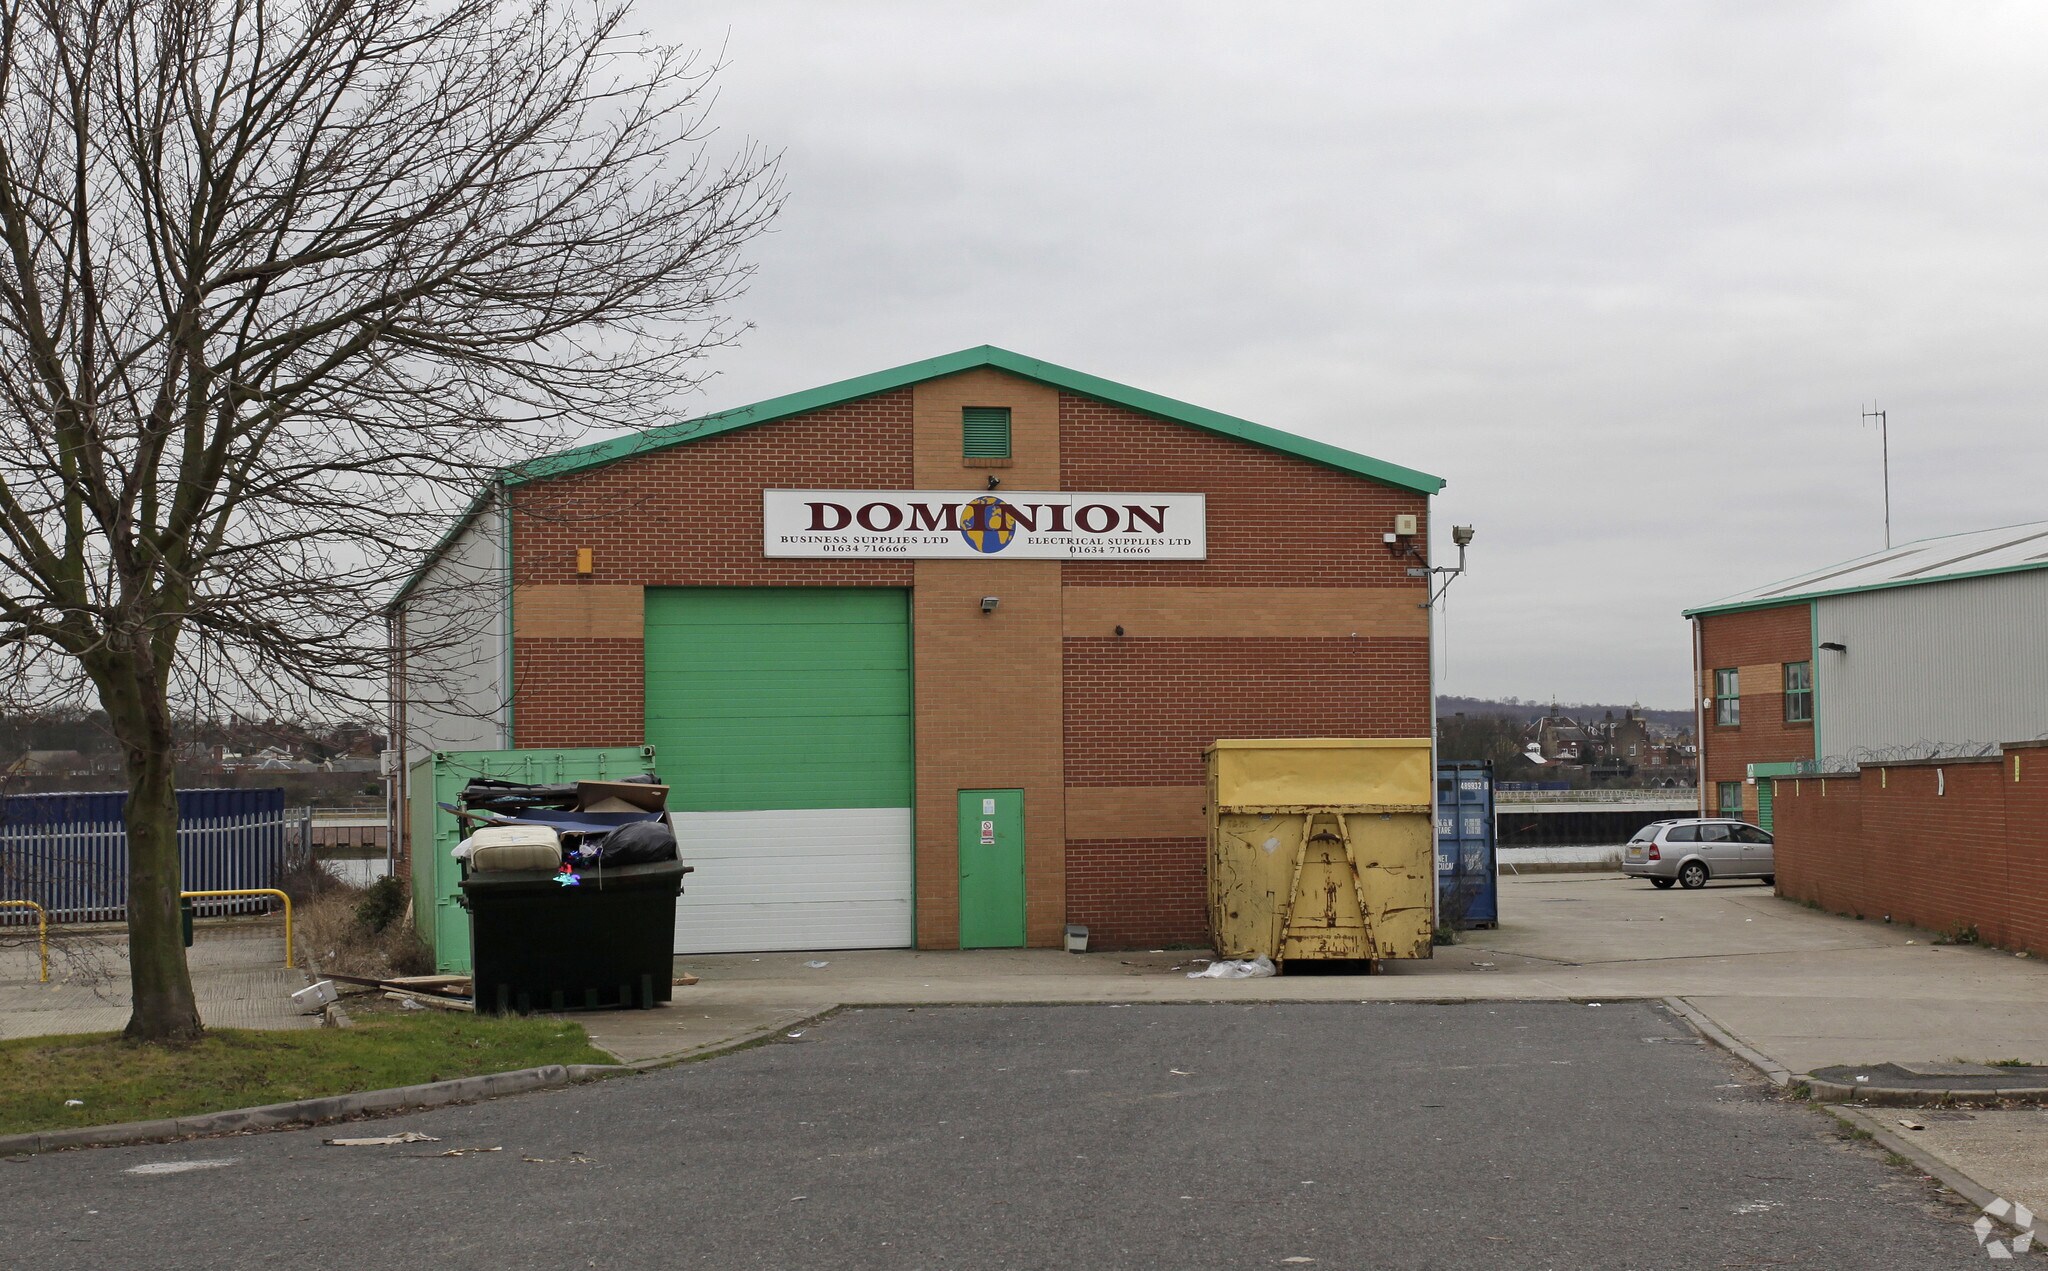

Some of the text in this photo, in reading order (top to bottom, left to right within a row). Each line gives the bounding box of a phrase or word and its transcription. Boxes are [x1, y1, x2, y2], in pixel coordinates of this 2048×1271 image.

[803, 502, 1170, 533] DOMINION
[780, 535, 949, 544] BUSINESS SUPPLIES LTD
[1028, 537, 1191, 546] ELECTRICAL SUPPLIES LTD
[823, 544, 907, 552] 01634 716666
[1069, 546, 1150, 554] 01634 716666
